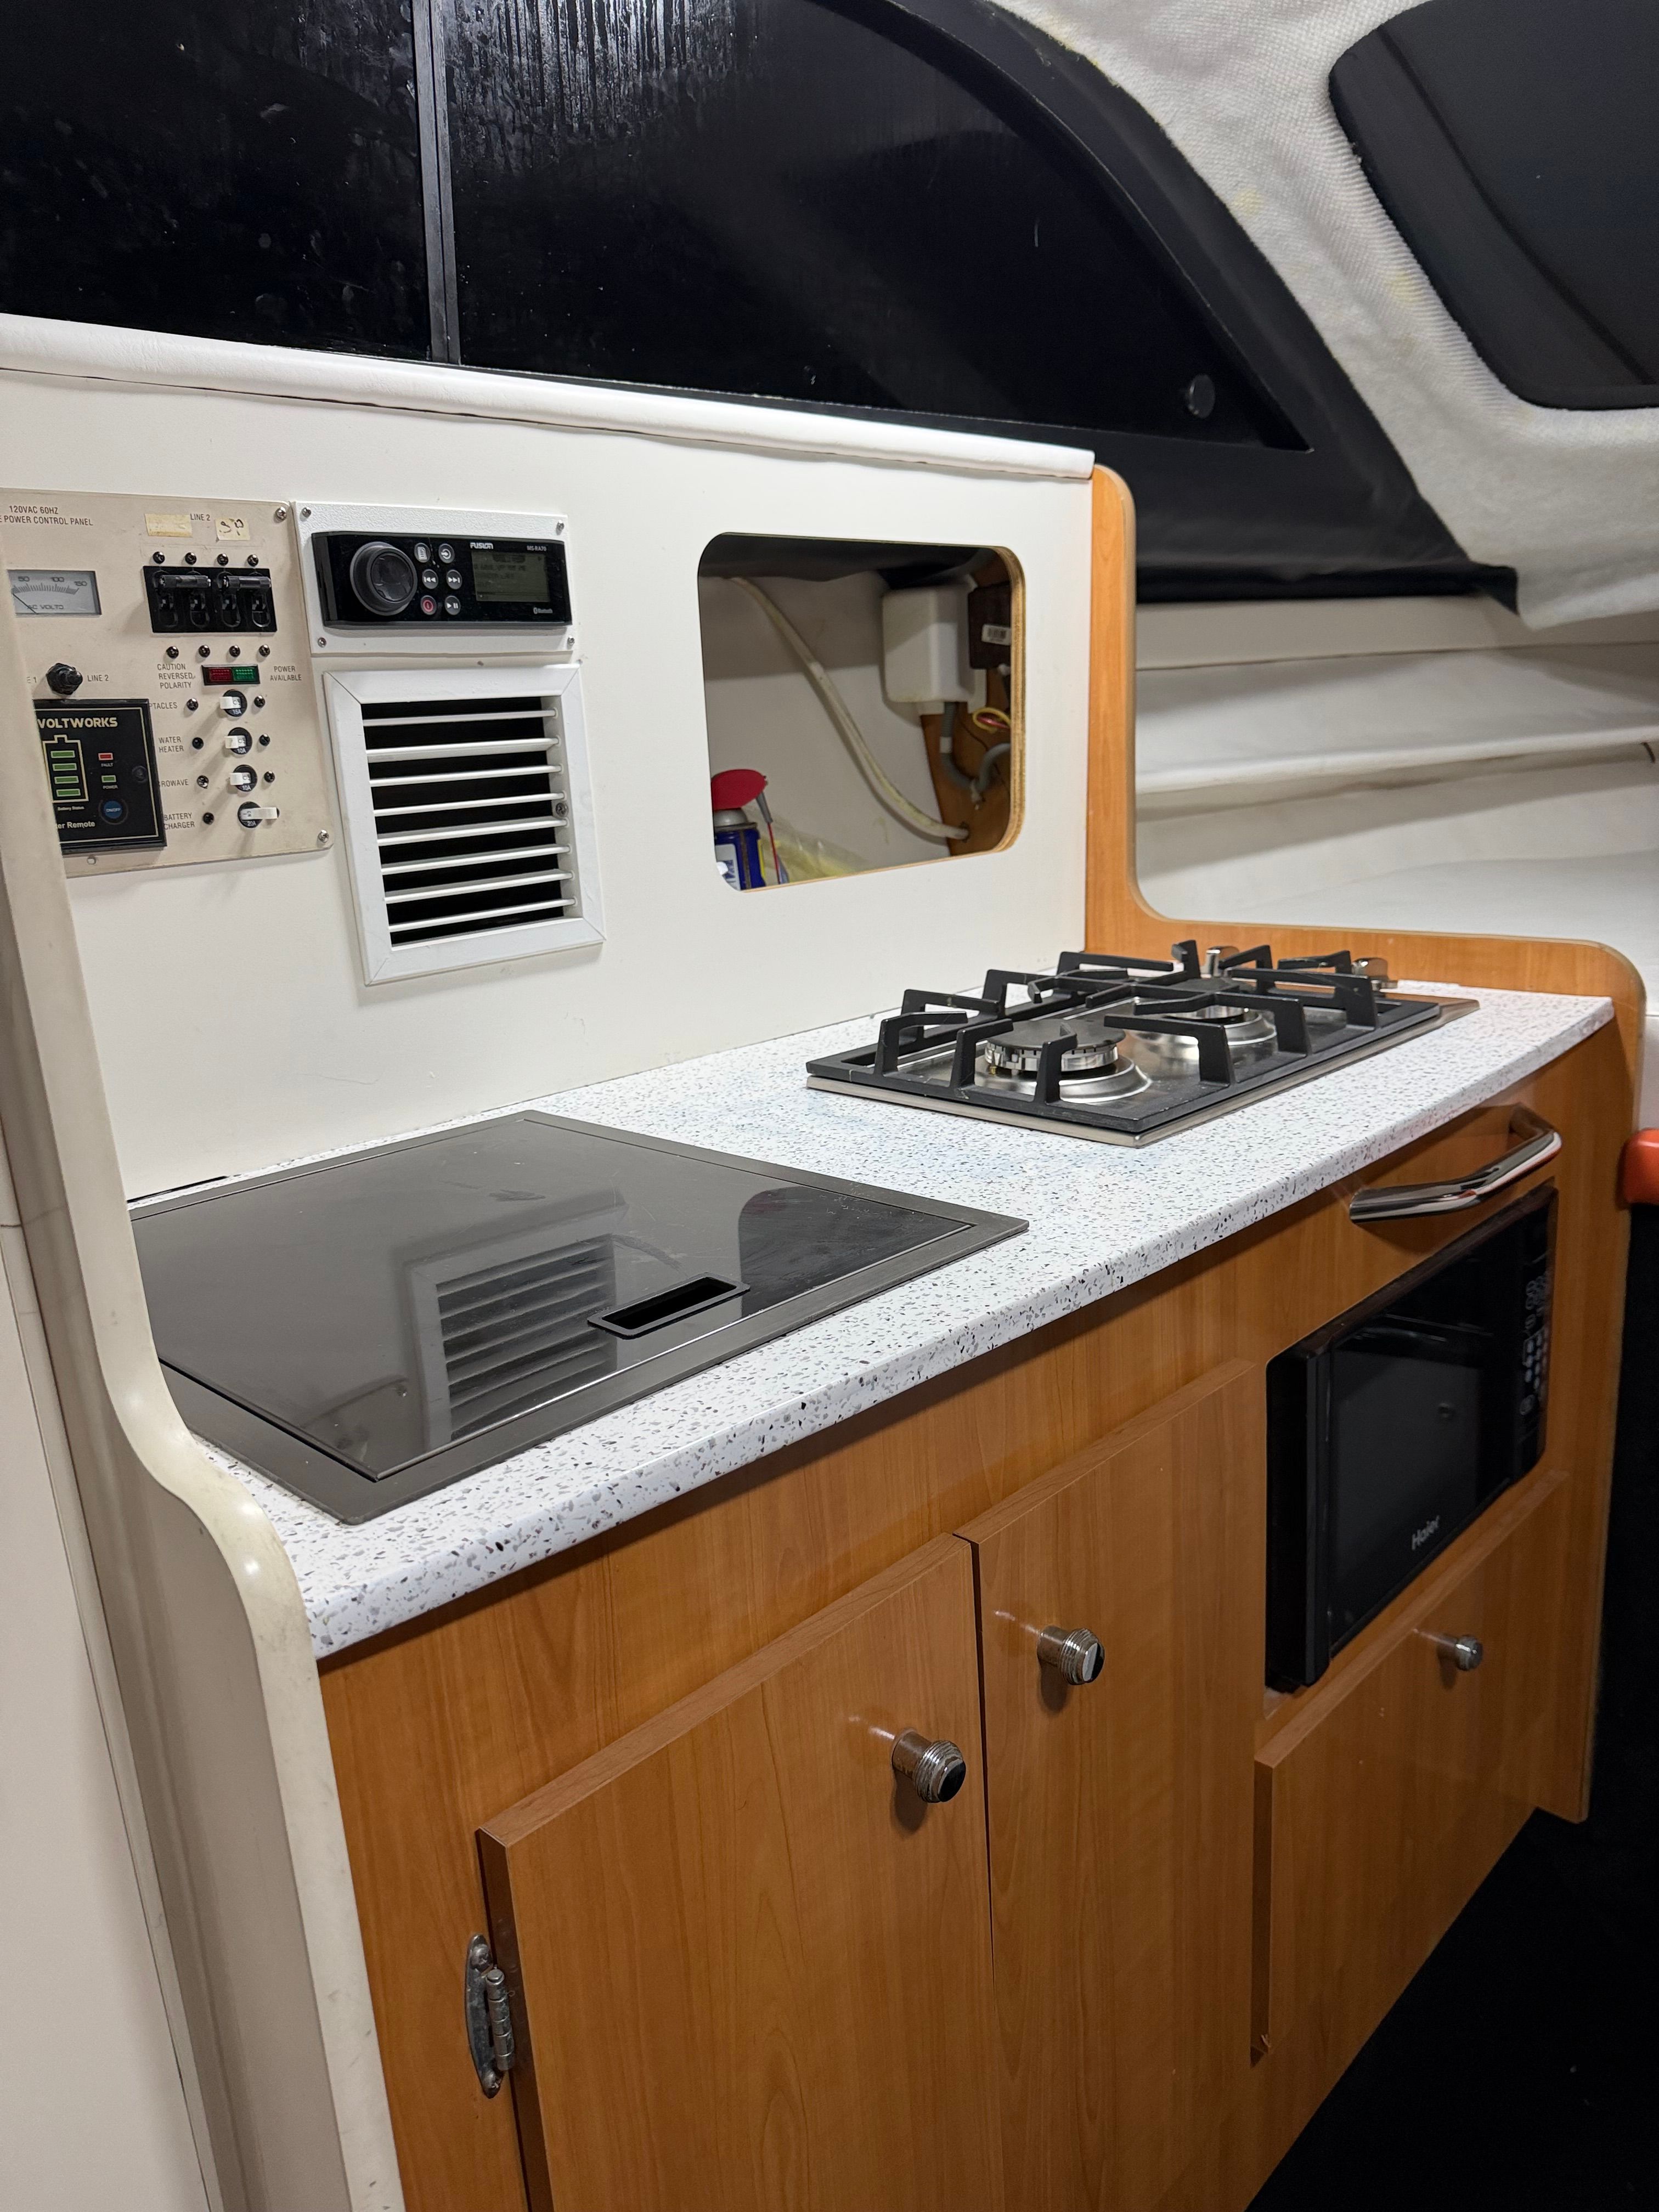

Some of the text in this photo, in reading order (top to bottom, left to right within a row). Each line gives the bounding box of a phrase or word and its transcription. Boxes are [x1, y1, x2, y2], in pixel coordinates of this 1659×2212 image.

[9, 505, 59, 515] 120VAC 60HZ
[4, 515, 31, 523] POWER
[33, 516, 69, 525] CONTROL
[70, 518, 94, 526] PANEL
[37, 717, 118, 729] VOLTWORKS
[164, 812, 192, 821] BATTERY
[66, 821, 95, 829] Remote
[164, 821, 195, 830] CHARGER
[1412, 1515, 1440, 1550] Haier
